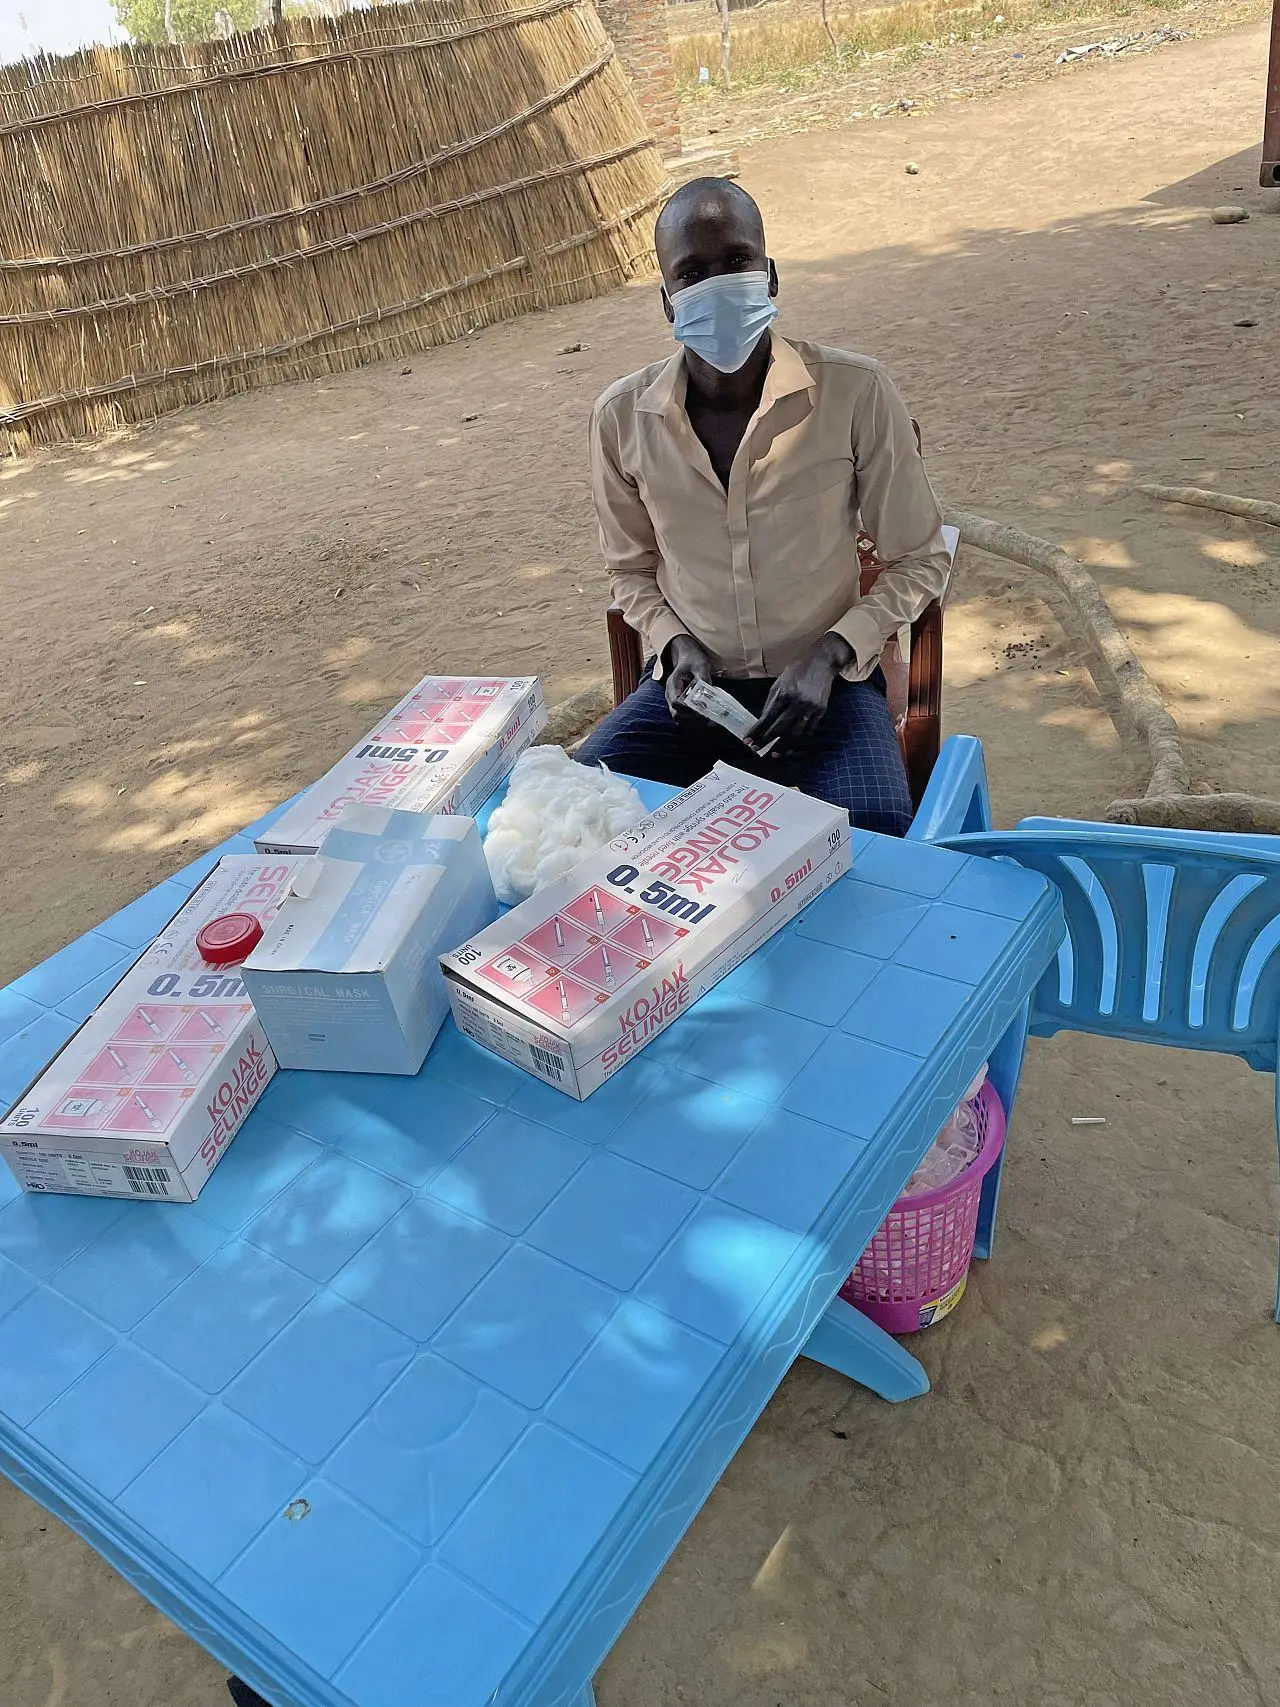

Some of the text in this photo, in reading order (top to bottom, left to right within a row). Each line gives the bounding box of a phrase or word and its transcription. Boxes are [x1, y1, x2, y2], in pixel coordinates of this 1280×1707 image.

[355, 744, 450, 764] 0.5ml
[360, 764, 418, 806] INGE
[734, 784, 749, 793] The
[650, 788, 774, 882] SELINGE
[828, 829, 840, 848] 100
[677, 819, 780, 894] KOJAK
[607, 864, 717, 924] 0.5ml
[770, 858, 812, 903] 0.5ml
[453, 944, 472, 959] UNITS
[458, 948, 482, 966] 100
[146, 973, 249, 998] 0.5m
[262, 984, 371, 998] SURGICAL MASK
[618, 963, 688, 1034] KOJAK
[601, 984, 690, 1070] SELINGE
[206, 1038, 261, 1124] KOJAK
[15, 1107, 40, 1127] 100
[200, 1058, 268, 1166] SELINGE
